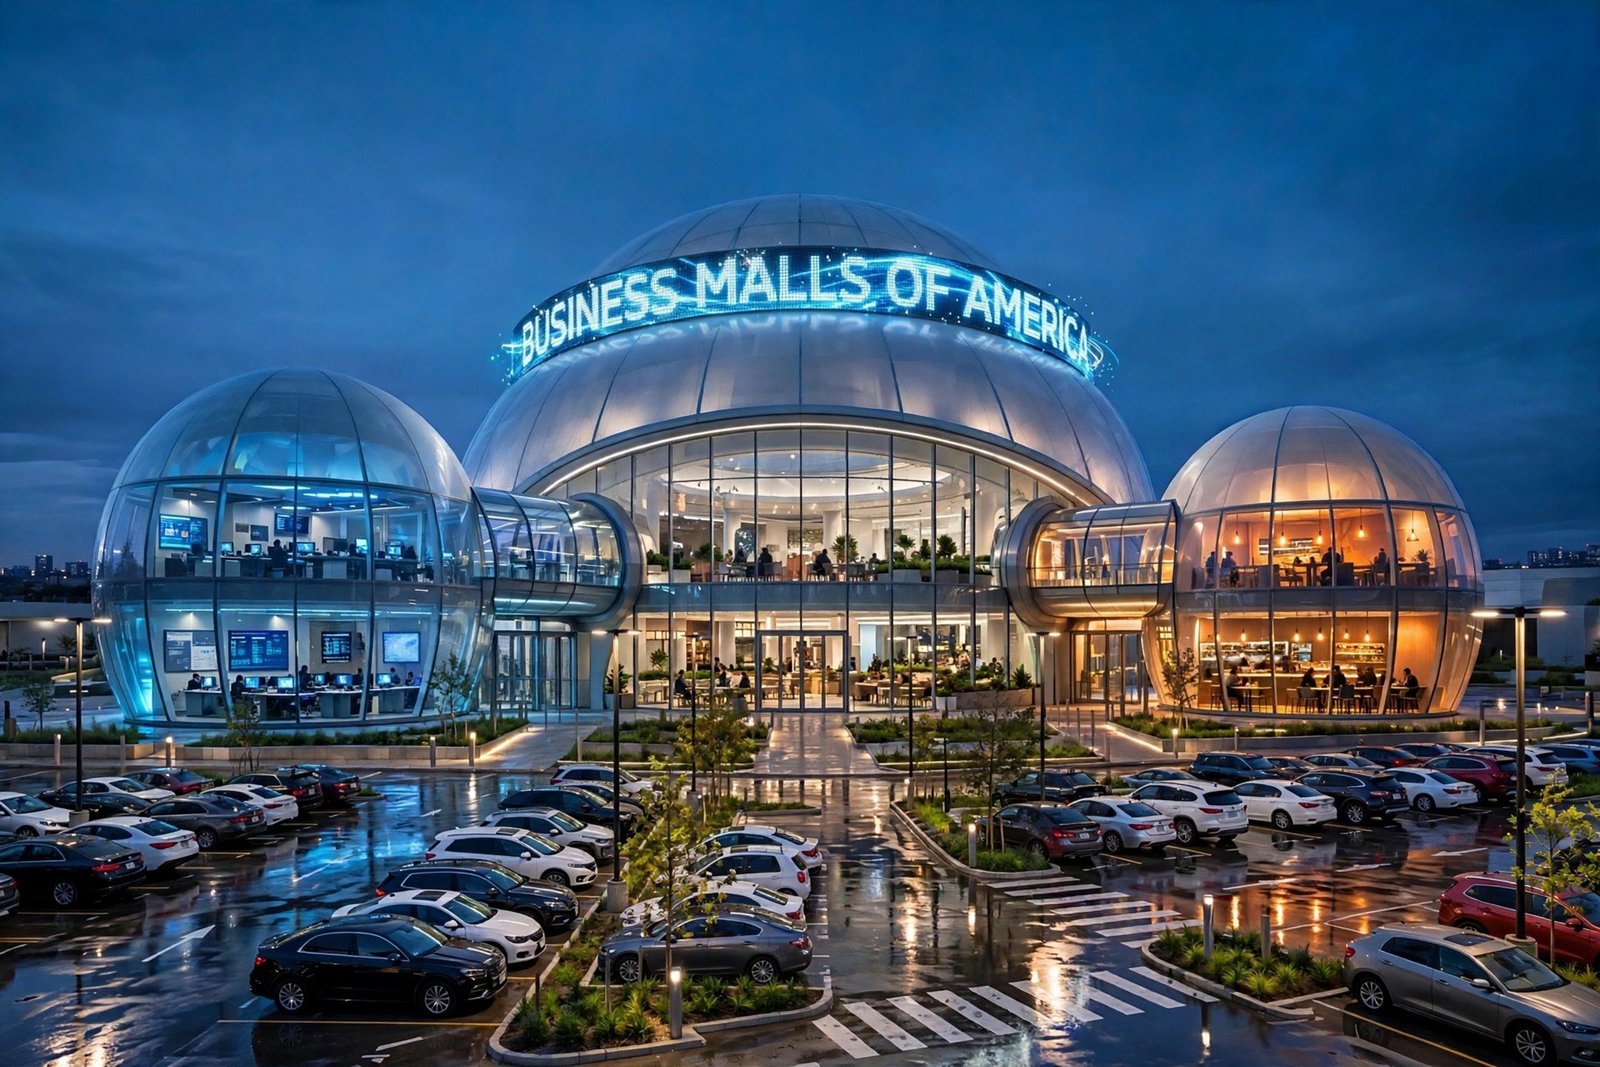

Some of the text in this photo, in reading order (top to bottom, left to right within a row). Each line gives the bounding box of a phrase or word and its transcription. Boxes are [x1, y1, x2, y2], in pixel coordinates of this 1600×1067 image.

[522, 255, 1090, 367] BUSINESS MALLS OF AMERICA
